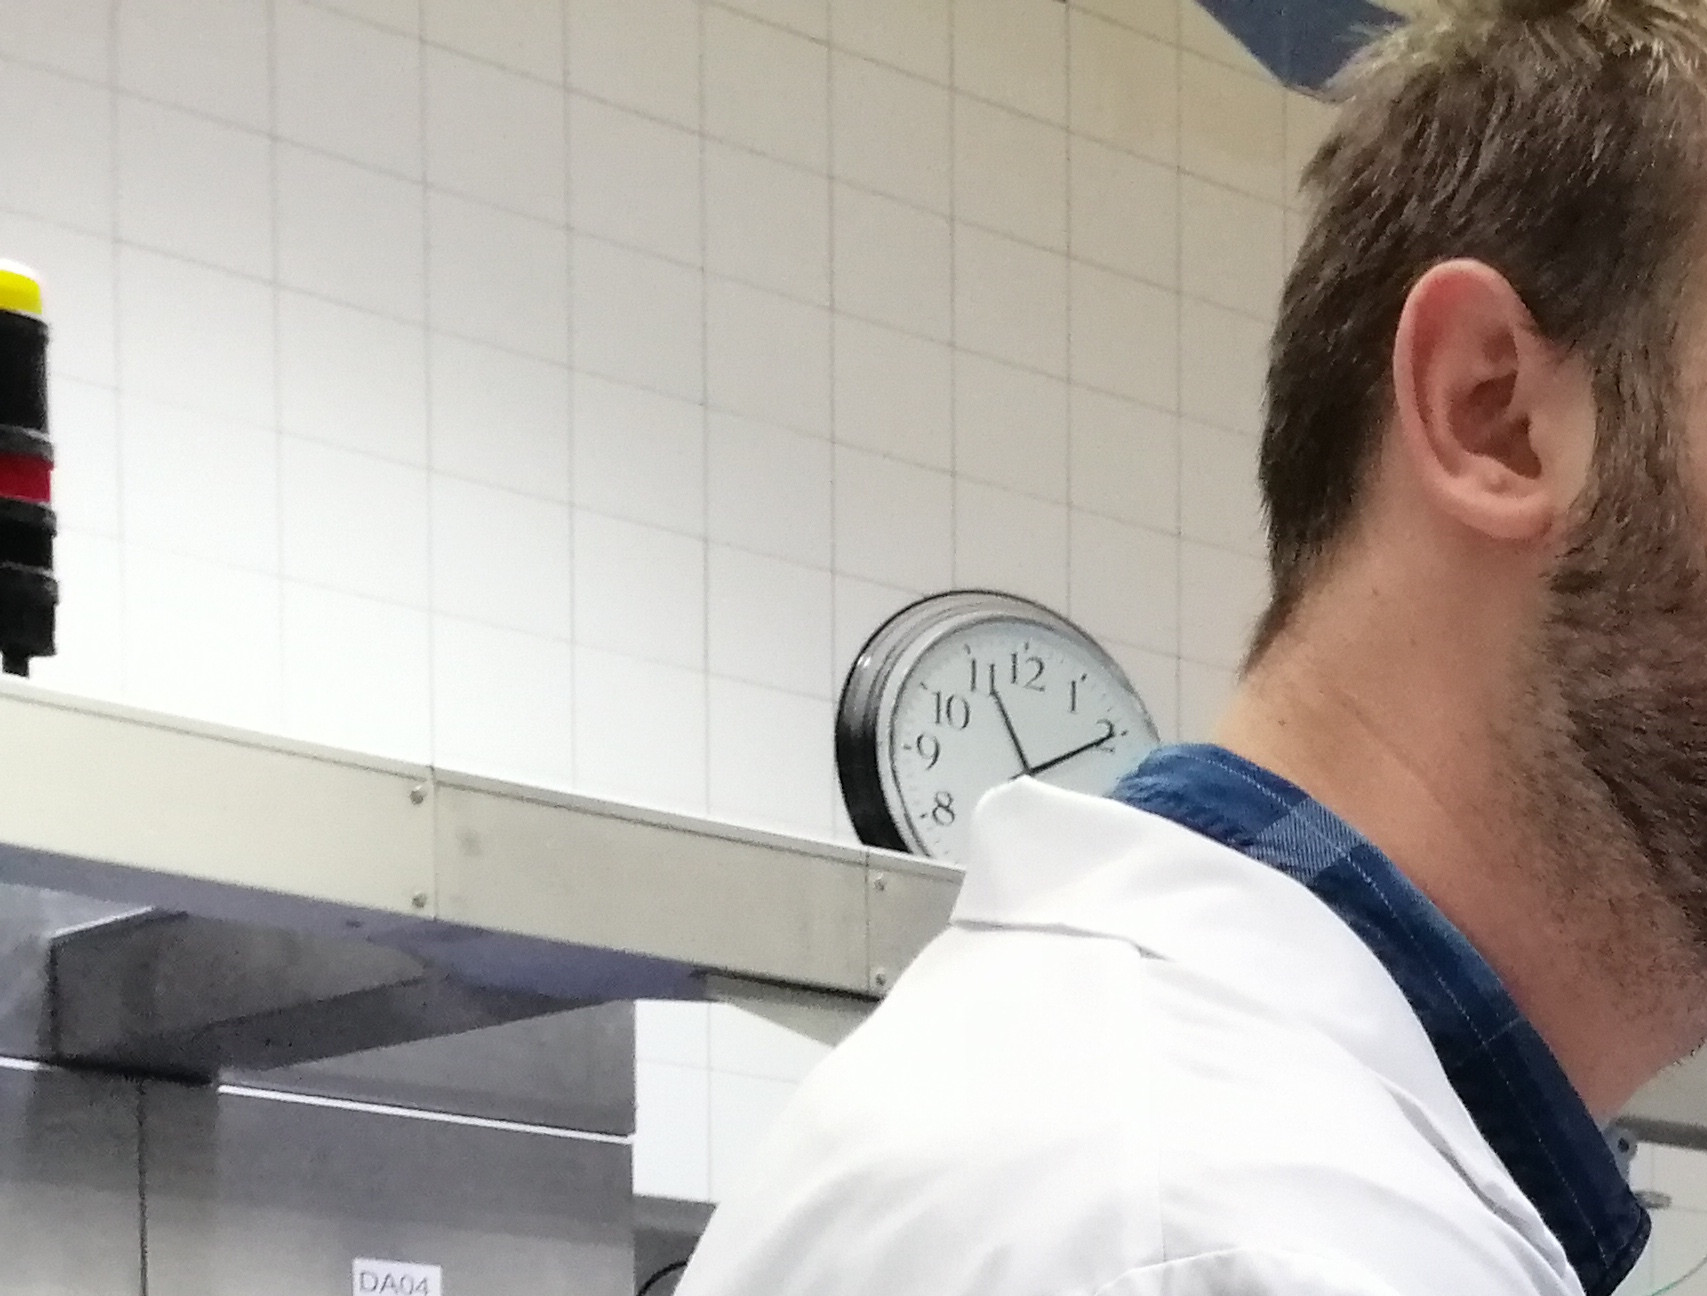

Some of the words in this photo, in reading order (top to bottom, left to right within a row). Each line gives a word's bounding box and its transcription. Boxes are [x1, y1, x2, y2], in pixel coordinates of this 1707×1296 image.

[969, 658, 996, 697] 11
[1009, 651, 1046, 692] 12
[933, 691, 970, 730] 10
[1068, 680, 1078, 713] 1
[916, 733, 941, 771] 9
[932, 791, 956, 826] 8
